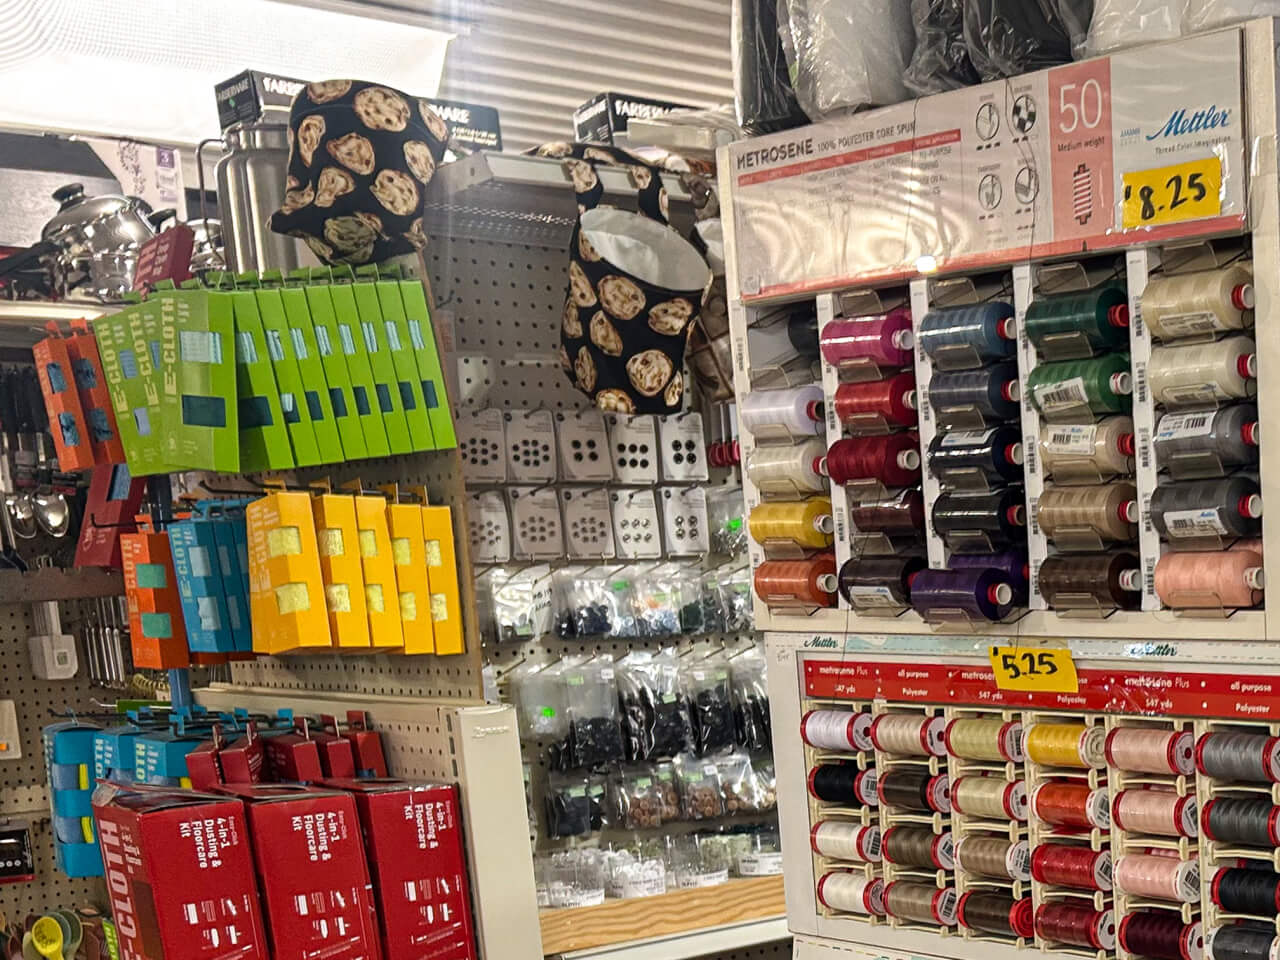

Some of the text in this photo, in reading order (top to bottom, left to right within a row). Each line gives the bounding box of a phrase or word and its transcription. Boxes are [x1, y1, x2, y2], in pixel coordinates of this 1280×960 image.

[1059, 78, 1103, 134] 50
[1146, 104, 1229, 141] Mettler
[737, 138, 813, 170] METROSENE
[817, 140, 837, 153] 100%
[838, 132, 875, 148] POLYESTER
[1057, 139, 1082, 152] Medium
[1083, 135, 1106, 151] weight
[161, 298, 178, 404] E-CLOTH
[171, 526, 193, 603] E-CLOTH
[1174, 677, 1190, 689] Plus
[1230, 682, 1272, 694] all purpose
[1235, 703, 1270, 714] Polyester
[179, 822, 192, 838] Kit
[291, 815, 303, 832] Kit
[327, 811, 341, 843] 4-in-1
[404, 805, 414, 820] Kit
[414, 803, 427, 849] Floorcare
[425, 802, 437, 841] Dusting
[436, 801, 447, 831] 4-in-1
[191, 820, 208, 869] Floorcare
[204, 819, 219, 859] Dusting
[217, 817, 231, 849] 4-in-1
[303, 814, 319, 862] Floorcare
[315, 813, 329, 852] Dusting
